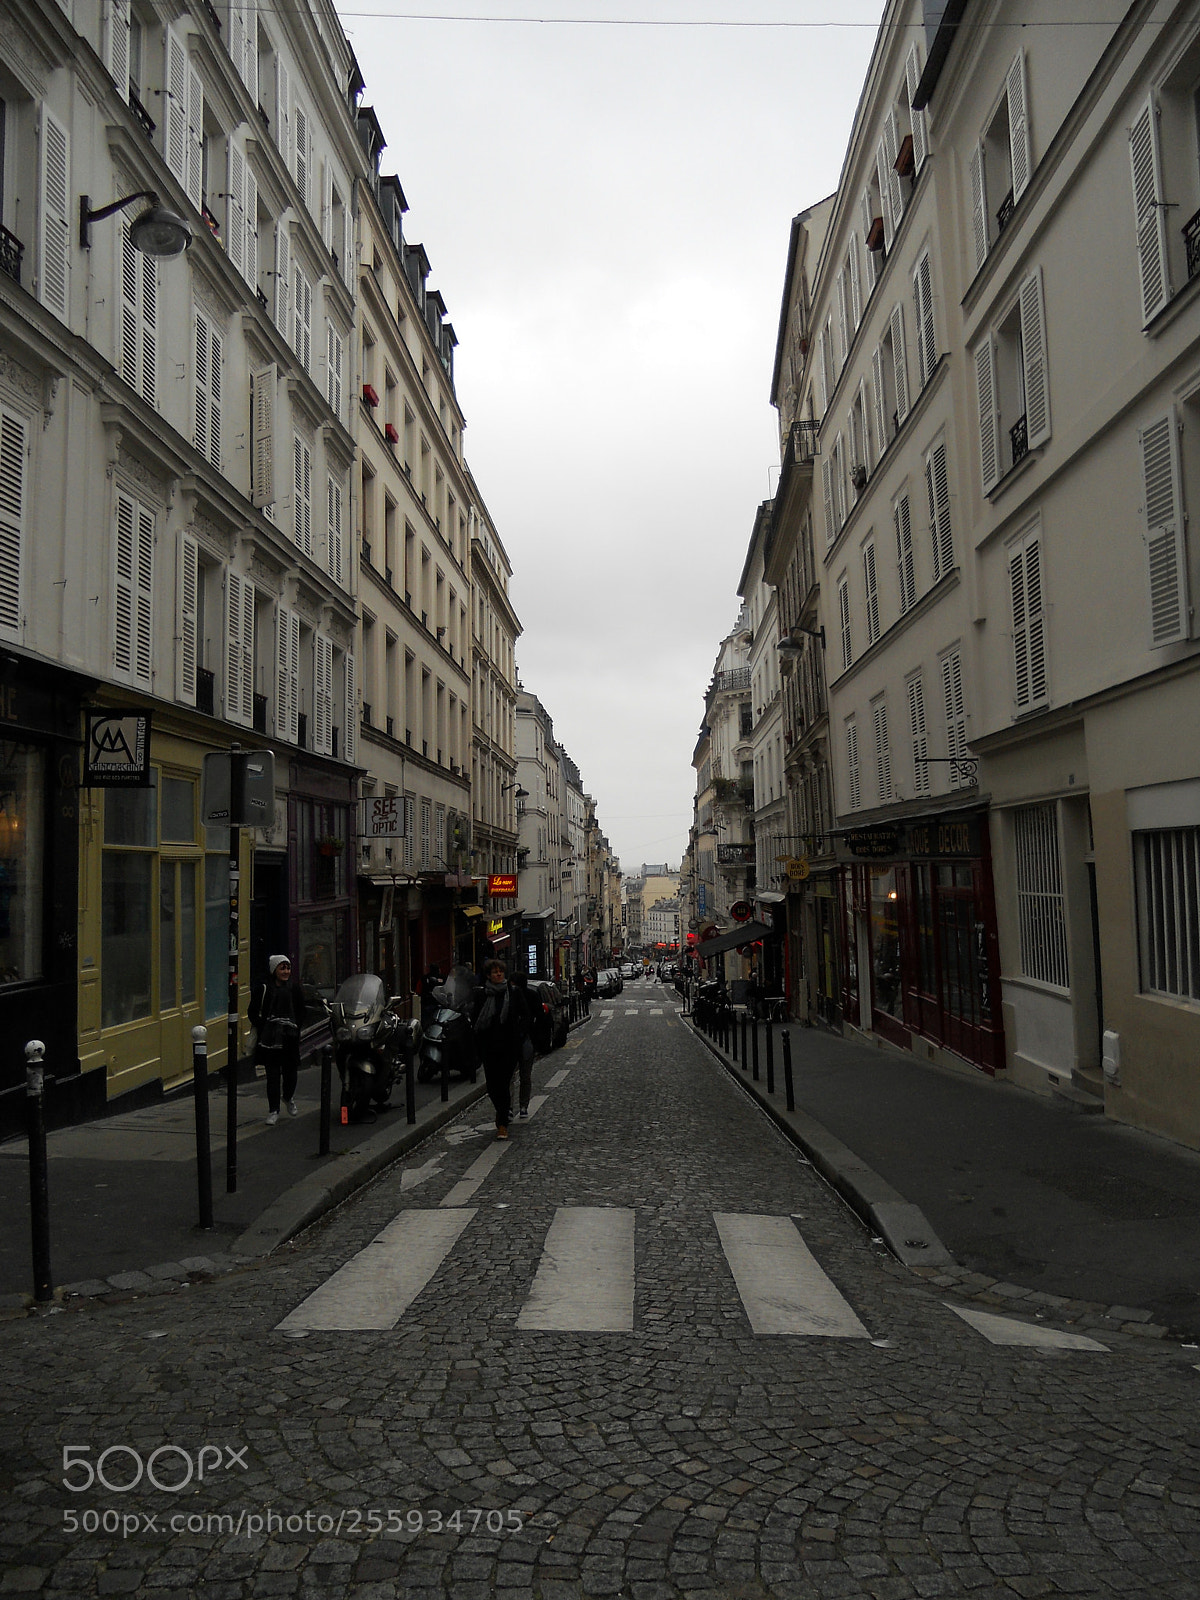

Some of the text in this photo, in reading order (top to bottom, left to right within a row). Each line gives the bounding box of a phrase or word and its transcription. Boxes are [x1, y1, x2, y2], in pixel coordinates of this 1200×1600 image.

[374, 797, 396, 814] SEE
[373, 821, 397, 834] OPTIC
[938, 824, 970, 853] DECOR
